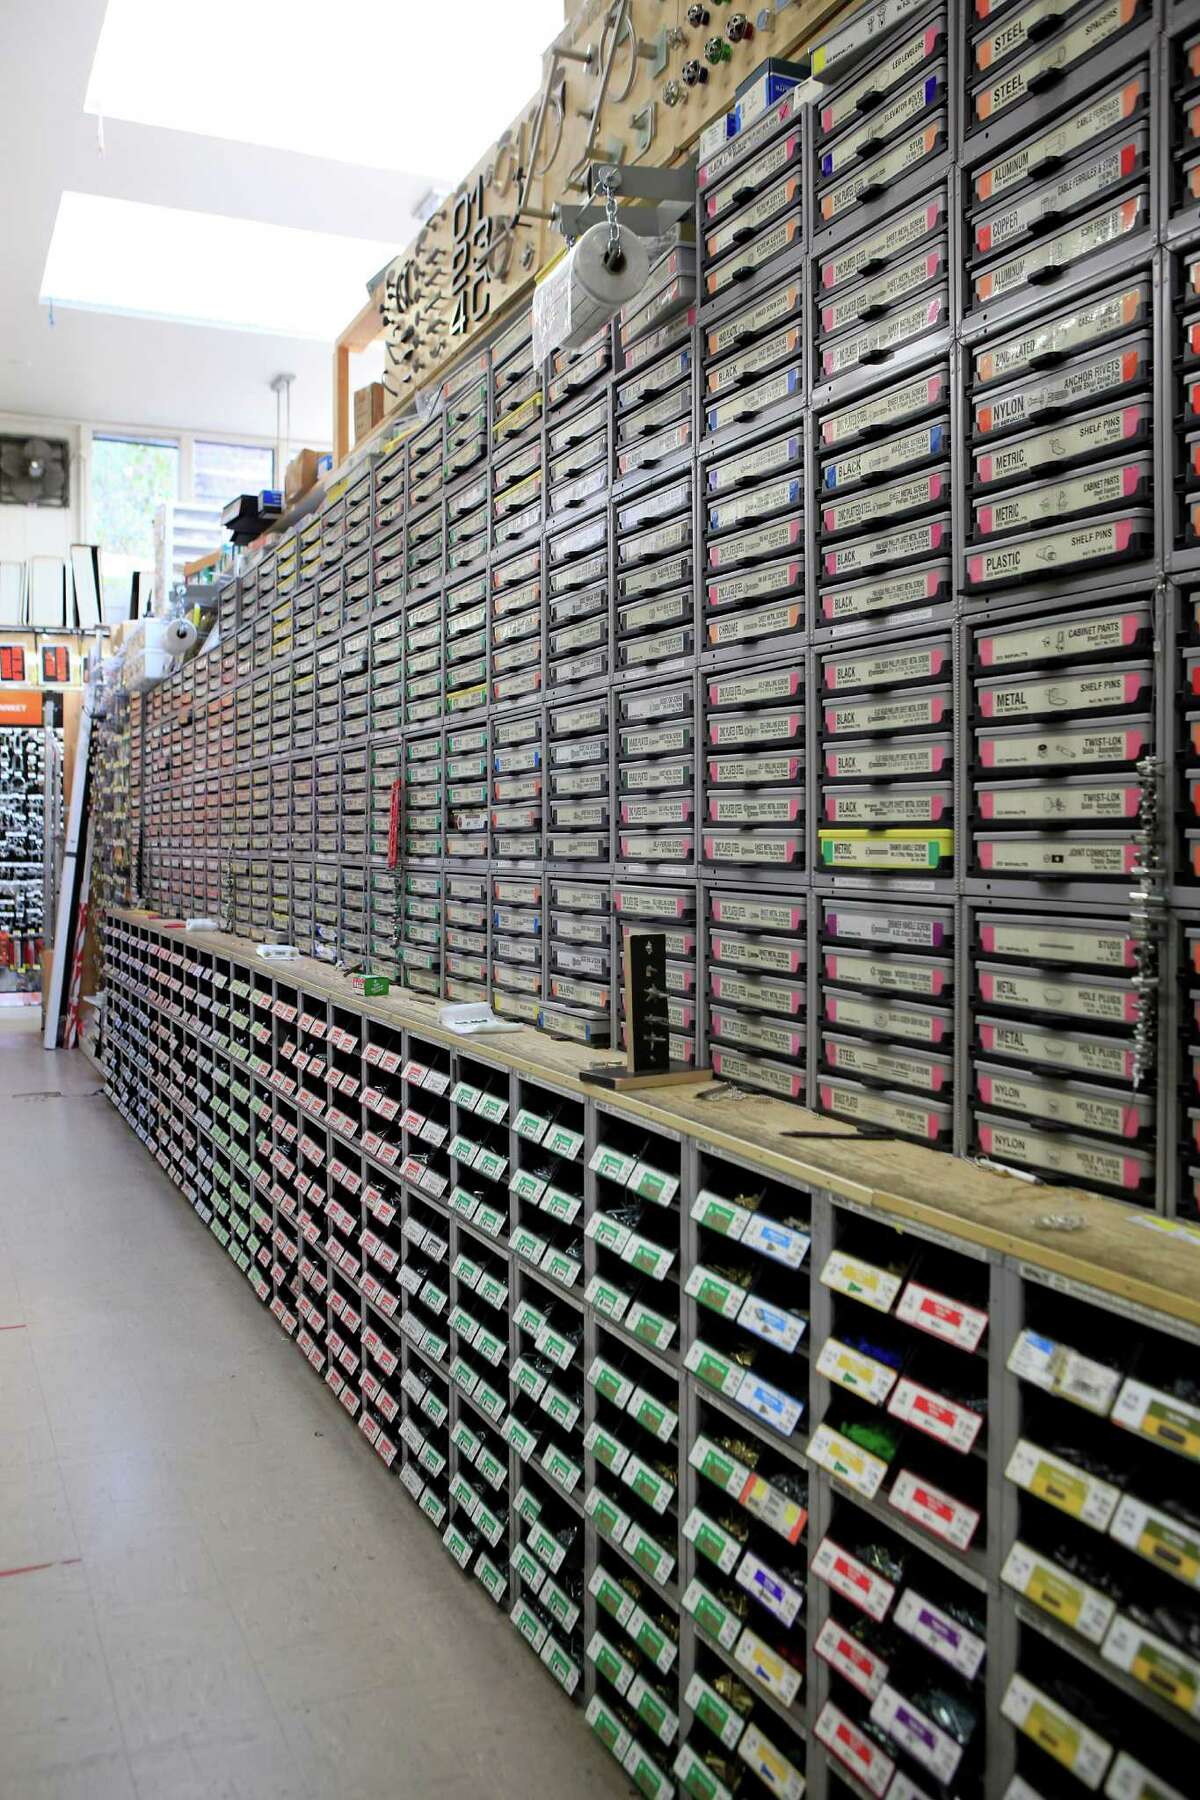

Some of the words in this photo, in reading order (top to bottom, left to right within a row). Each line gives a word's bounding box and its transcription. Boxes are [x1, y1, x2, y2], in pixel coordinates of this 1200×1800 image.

[994, 20, 1025, 51] STEEL
[993, 74, 1024, 102] STEEL
[994, 151, 1029, 183] ALUMINUM
[992, 210, 1018, 238] COPPER
[719, 365, 738, 382] BLACK
[1064, 369, 1093, 389] ANCHOR
[1094, 359, 1120, 377] RIVETS
[993, 395, 1024, 420] NYLON
[1080, 421, 1102, 437] SHELF
[1103, 416, 1120, 429] PINS
[838, 456, 862, 478] BLACK
[996, 449, 1024, 470] METRIC
[1083, 480, 1103, 492] CABINET
[1104, 475, 1120, 486] PARTS
[996, 504, 1019, 521] METRIC
[1072, 534, 1094, 546] SHELF
[1095, 528, 1112, 540] PINS
[837, 550, 856, 566] BLACK
[986, 551, 1021, 571] PLASTIC
[835, 596, 853, 610] BLACK
[1068, 626, 1097, 638] CABINET
[1098, 621, 1119, 632] PARTS
[837, 667, 856, 679] BLACK
[1080, 682, 1103, 693] SHELF
[1104, 680, 1121, 689] PINS
[996, 692, 1026, 707] METAL
[837, 711, 855, 725] BLACK
[1084, 736, 1122, 747] TWIST-LOK
[838, 757, 856, 770] BLACK
[839, 801, 857, 813] BLACK
[996, 1027, 1024, 1046] METAL
[839, 1048, 856, 1062] STEEL
[994, 1084, 1020, 1099] NYLON
[1076, 1101, 1094, 1112] HOLE
[1095, 1103, 1119, 1117] PLUGS
[995, 1134, 1025, 1150] NYLON
